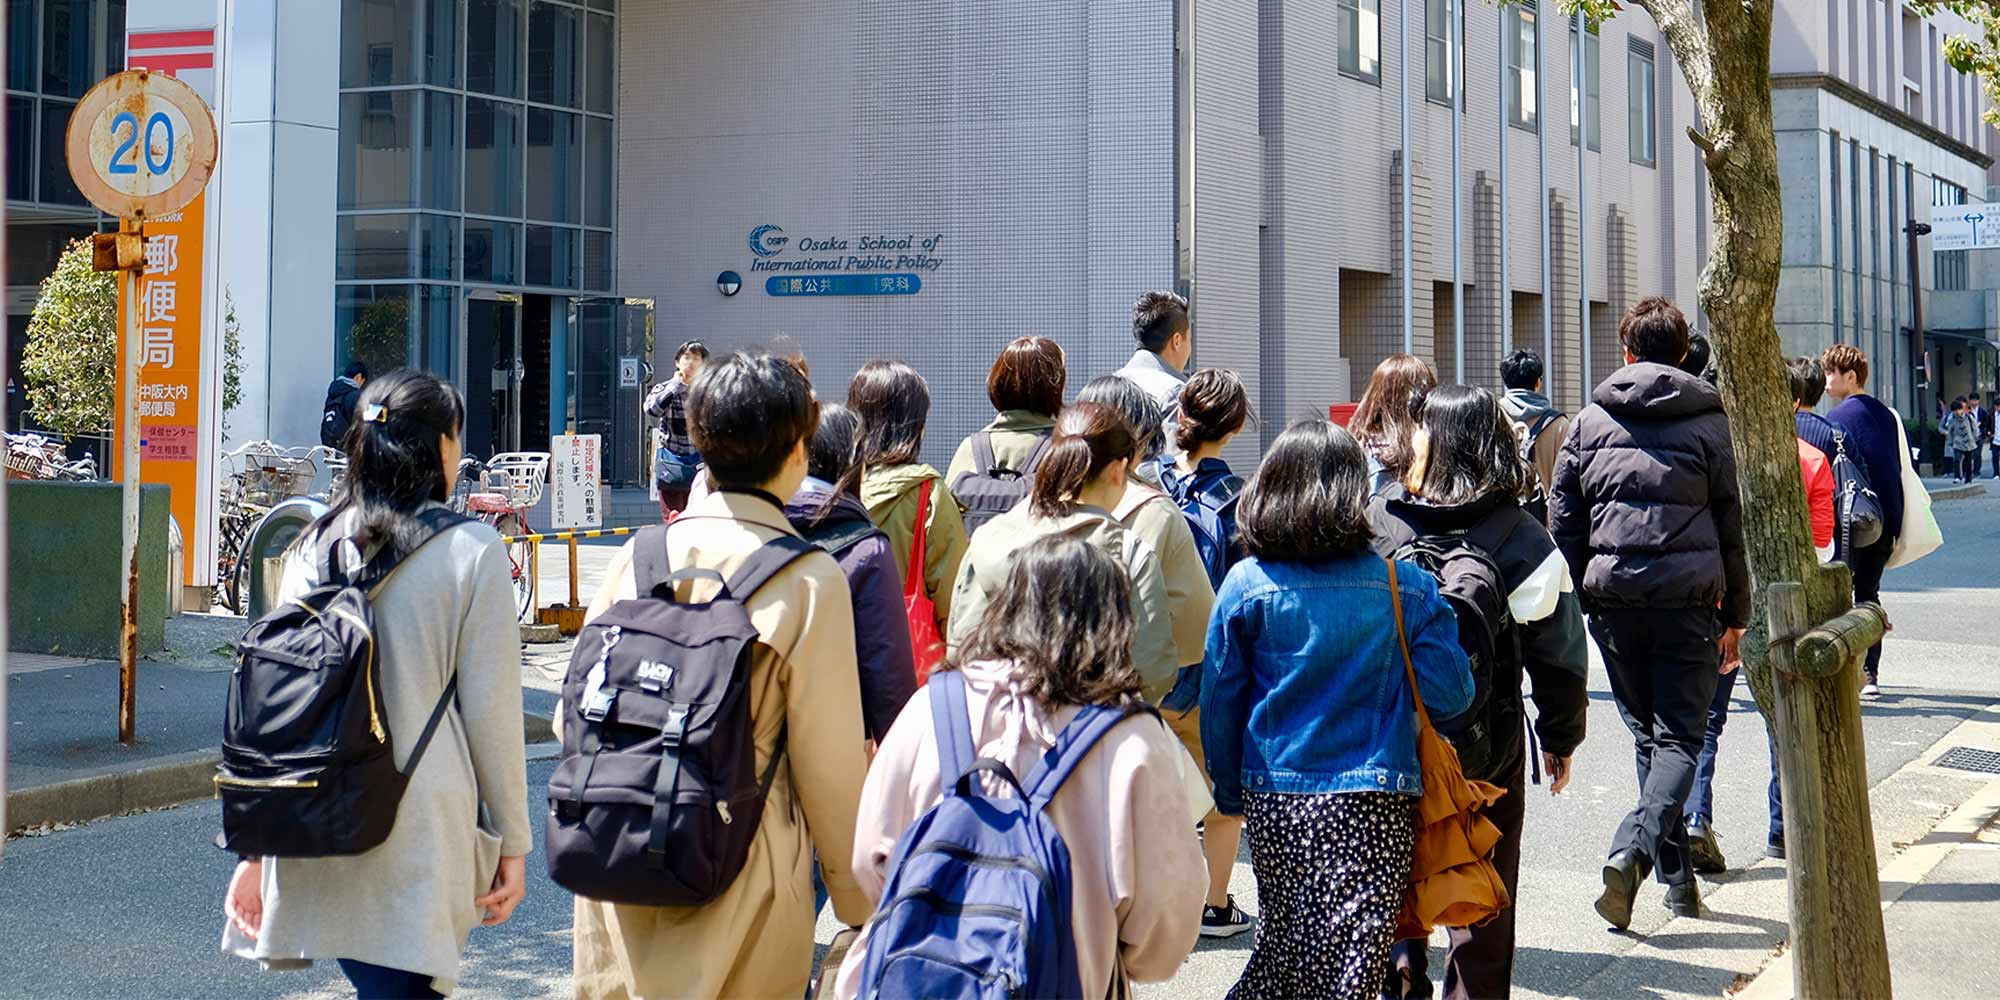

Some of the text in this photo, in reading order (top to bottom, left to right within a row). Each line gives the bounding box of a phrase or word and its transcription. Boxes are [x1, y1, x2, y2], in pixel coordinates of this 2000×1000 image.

[109, 112, 174, 175] 20
[799, 234, 943, 252] Osaka School of
[751, 254, 943, 272] International Public Policy
[141, 234, 179, 370] 郵便局
[140, 401, 176, 417] 郵便局
[149, 427, 195, 437] 保健センター
[149, 445, 187, 455] 学生相談室
[571, 438, 581, 487] 禁止します。
[584, 438, 595, 523] 指定区域外への駐車を
